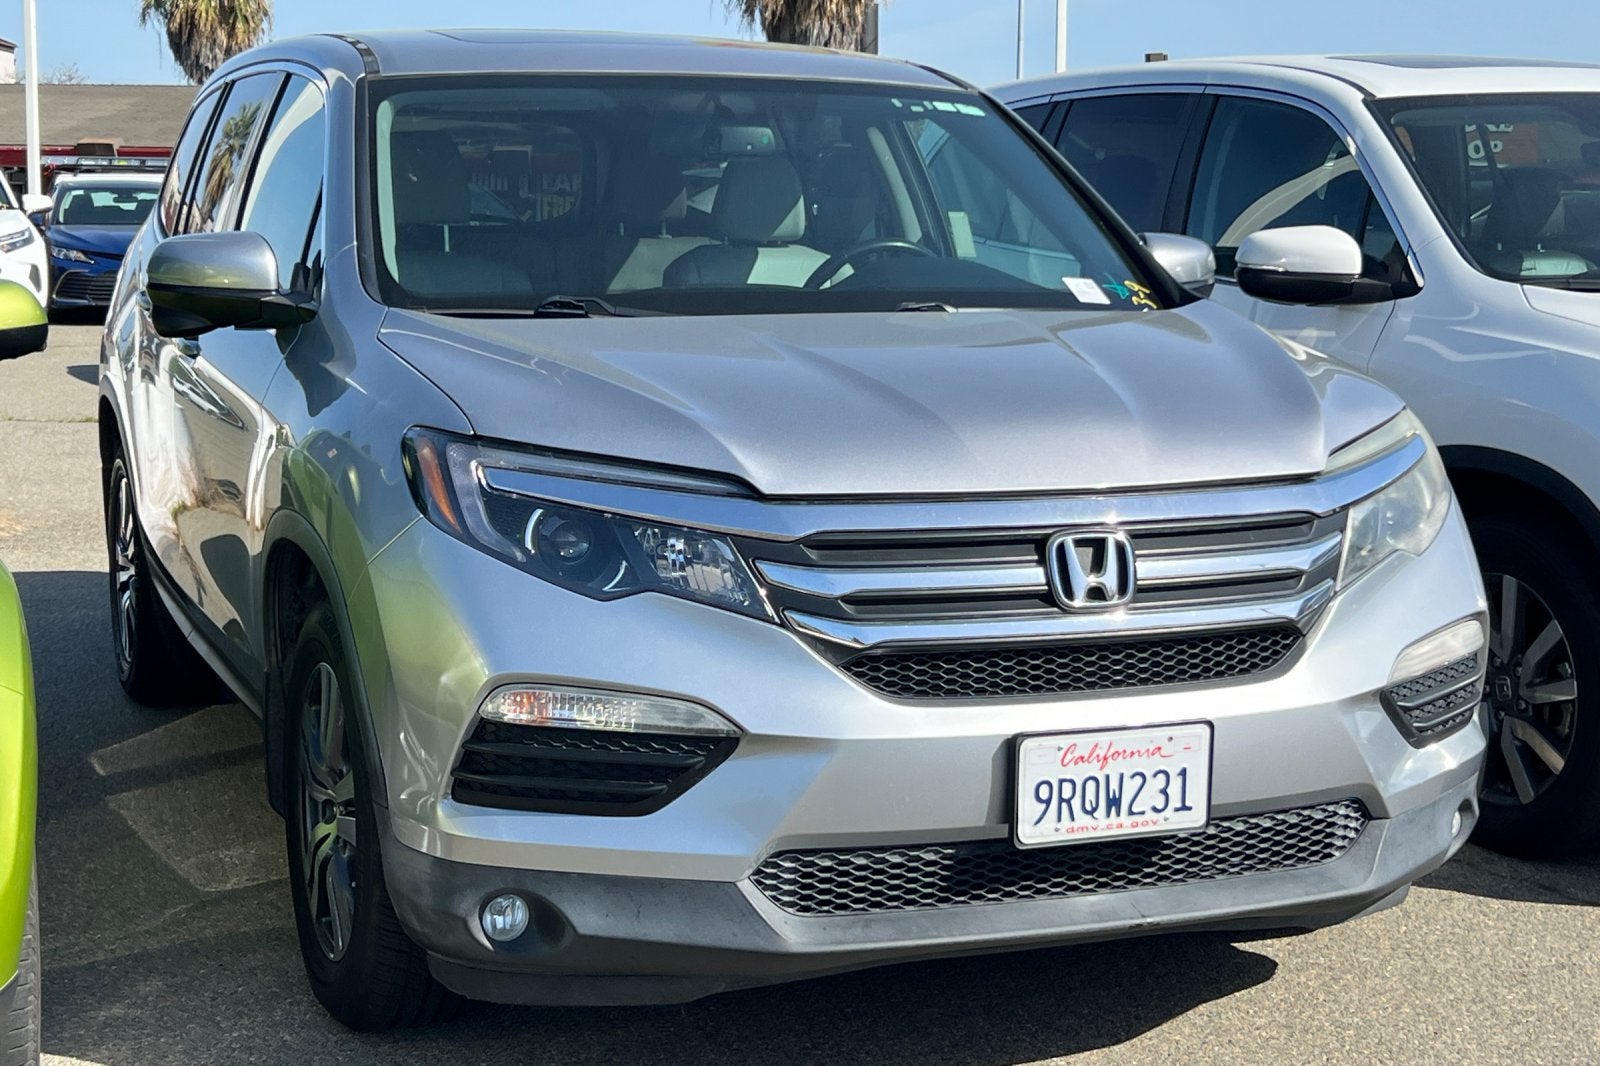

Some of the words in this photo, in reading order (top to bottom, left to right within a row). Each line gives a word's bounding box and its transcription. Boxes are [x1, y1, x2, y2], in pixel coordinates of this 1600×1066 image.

[1060, 741, 1174, 771] California
[1033, 766, 1193, 827] 9RQW231
[1065, 818, 1161, 834] dmv.ca.gov
